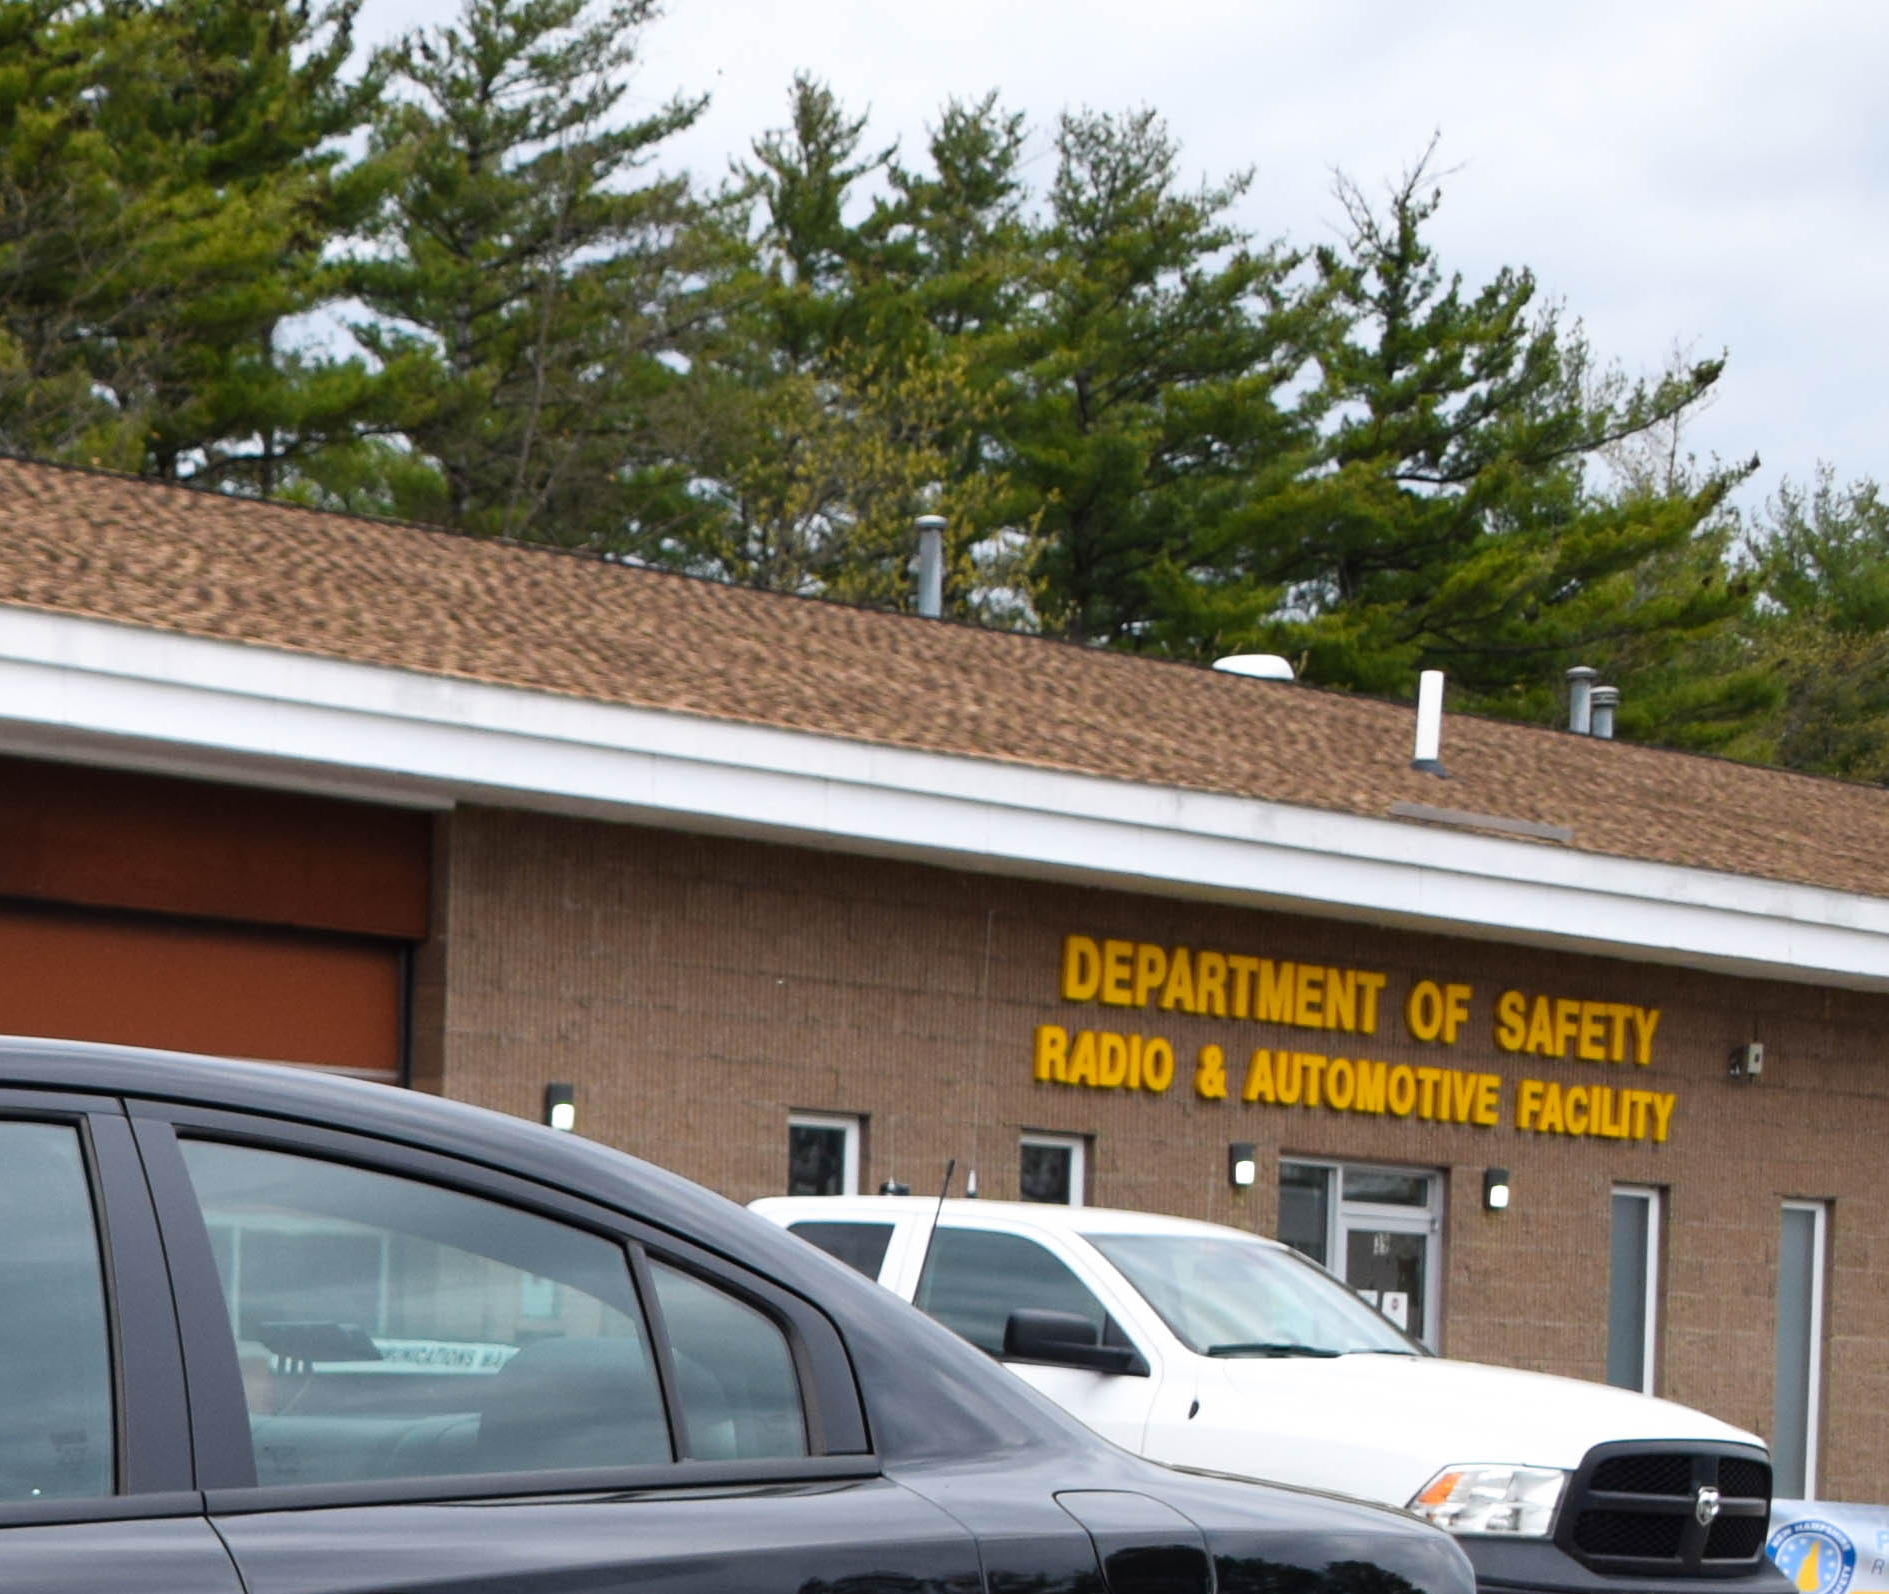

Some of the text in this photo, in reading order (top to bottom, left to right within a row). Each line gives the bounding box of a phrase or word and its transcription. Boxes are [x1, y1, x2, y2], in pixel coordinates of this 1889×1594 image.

[1064, 936, 1659, 1066] DEPARTMENT OF SAFETY
[1035, 1024, 1677, 1142] RADIO & AUTOMOTIVE FACILITY
[1772, 1527, 1793, 1546] NEW
[1794, 1522, 1851, 1551] HAMPSHIRE
